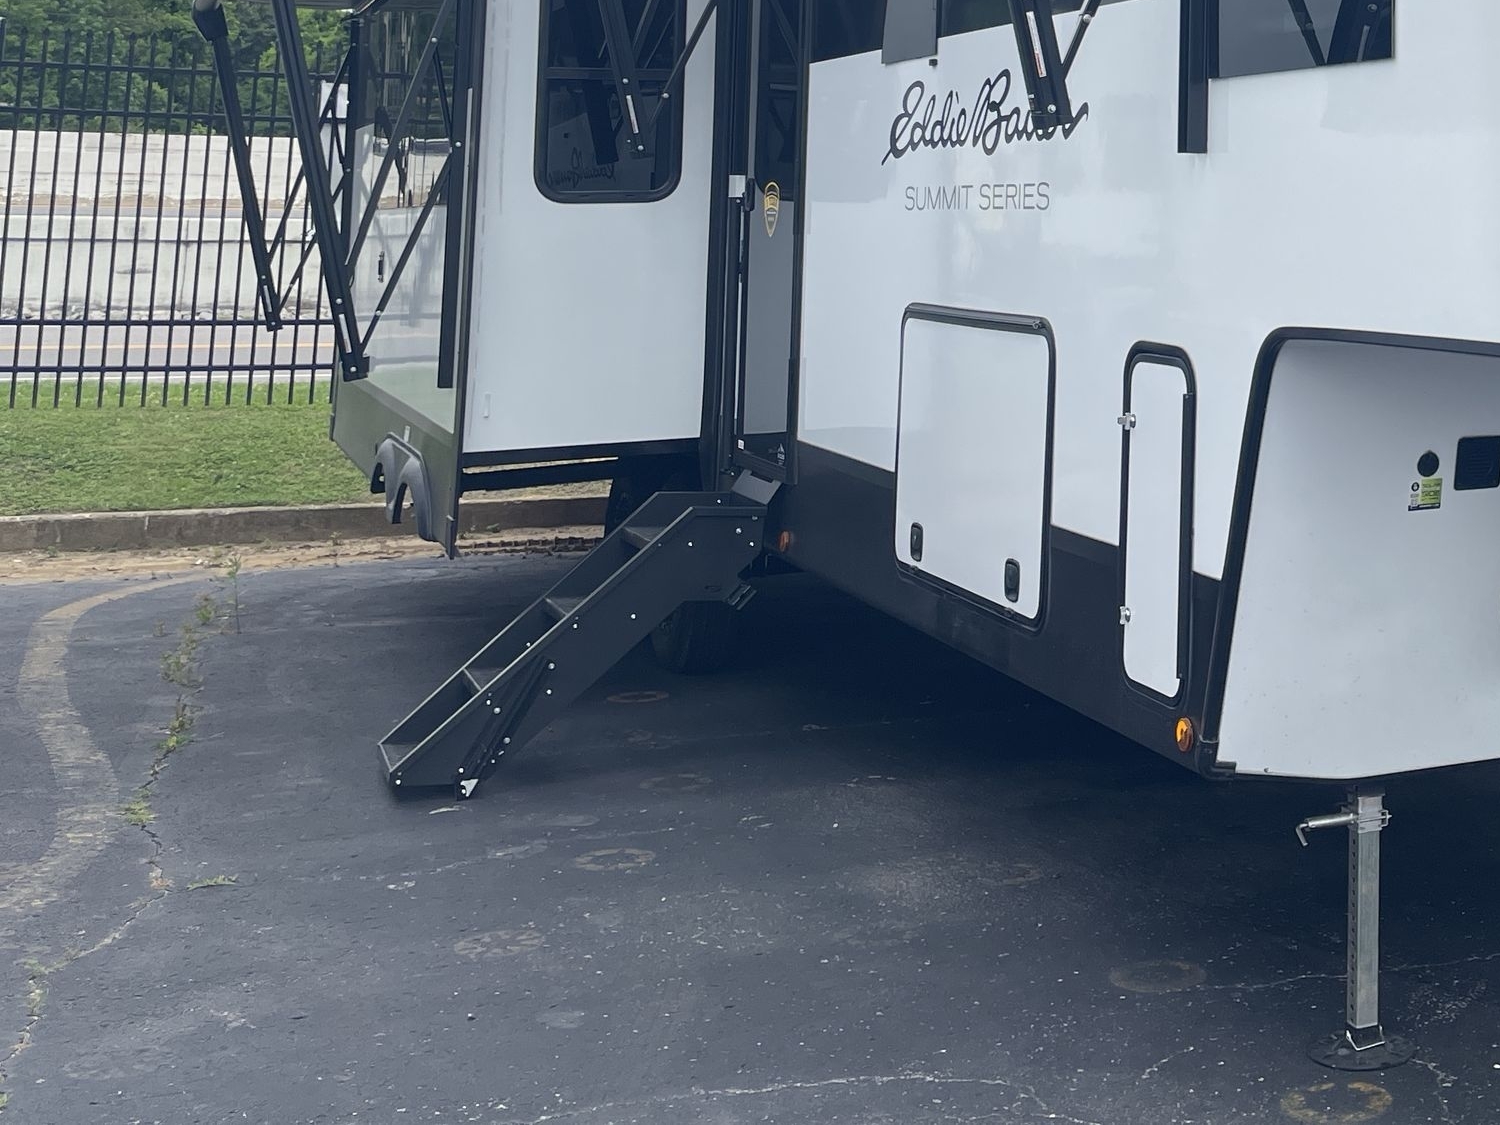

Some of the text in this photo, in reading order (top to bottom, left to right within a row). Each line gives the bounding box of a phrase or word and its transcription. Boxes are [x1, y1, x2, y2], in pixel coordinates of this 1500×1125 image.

[881, 80, 970, 166] Eddie
[904, 181, 1050, 211] SUMMIT SERIES
